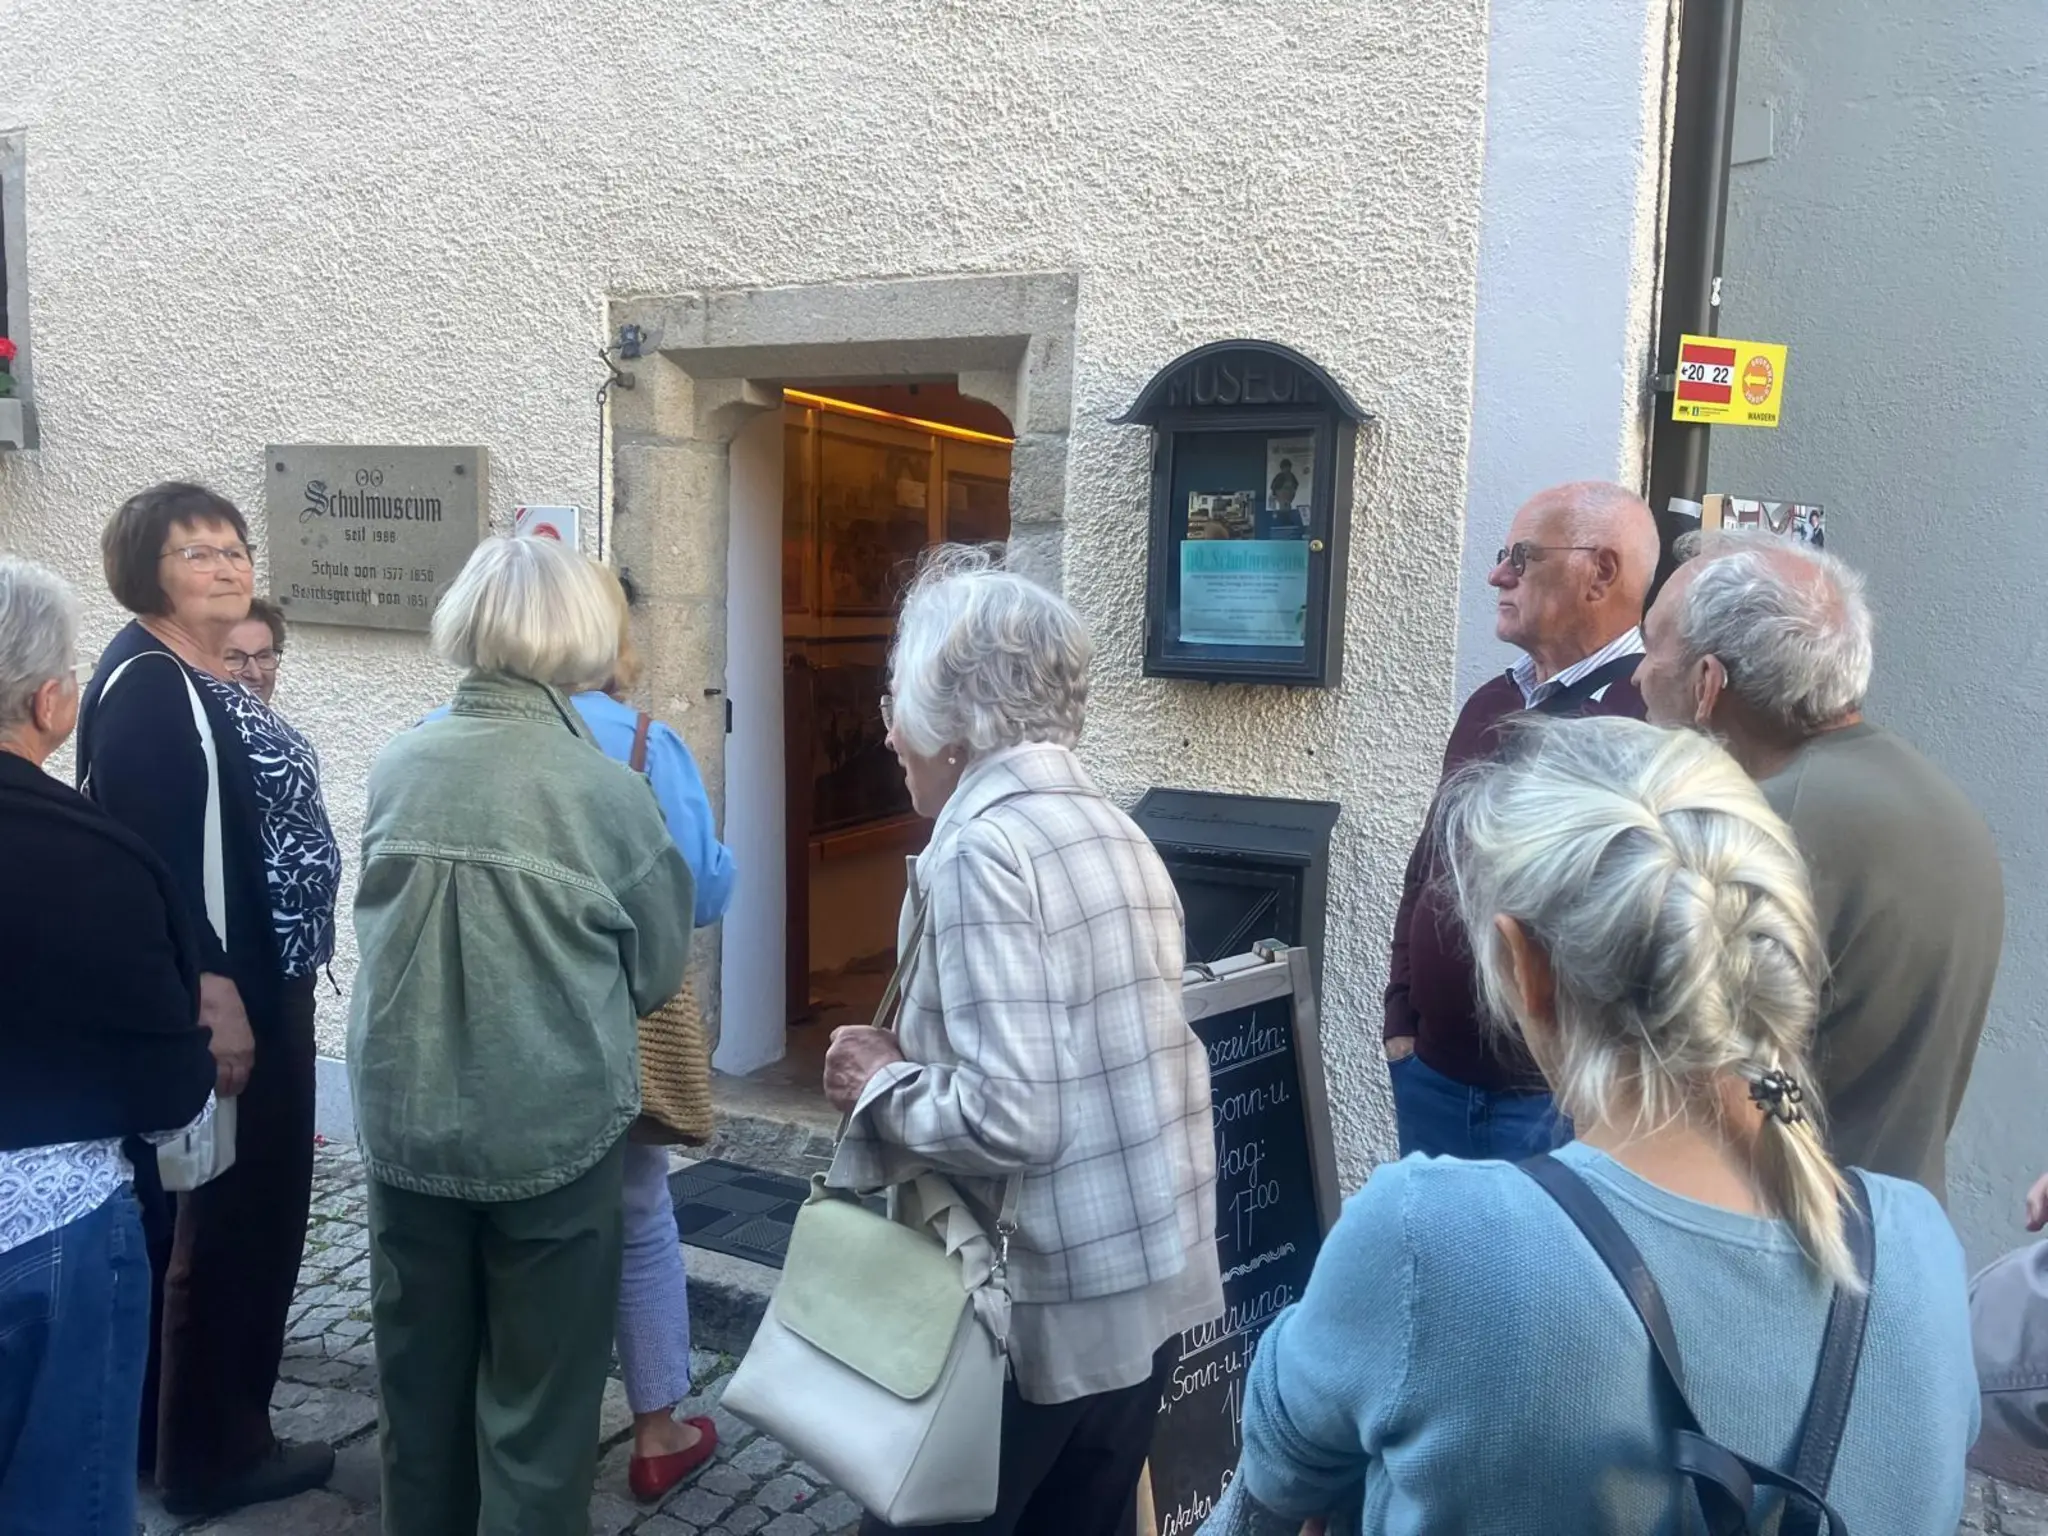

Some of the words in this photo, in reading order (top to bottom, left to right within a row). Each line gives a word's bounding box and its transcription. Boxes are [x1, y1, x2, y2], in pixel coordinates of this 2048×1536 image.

[1687, 364, 1705, 381] 20
[1712, 367, 1729, 384] 22
[299, 480, 442, 524] Schulmuseum
[312, 560, 349, 580] Schule
[354, 565, 377, 579] von
[378, 592, 400, 605] von
[1208, 1010, 1286, 1066] szeiten:
[1216, 1131, 1265, 1189] tag:
